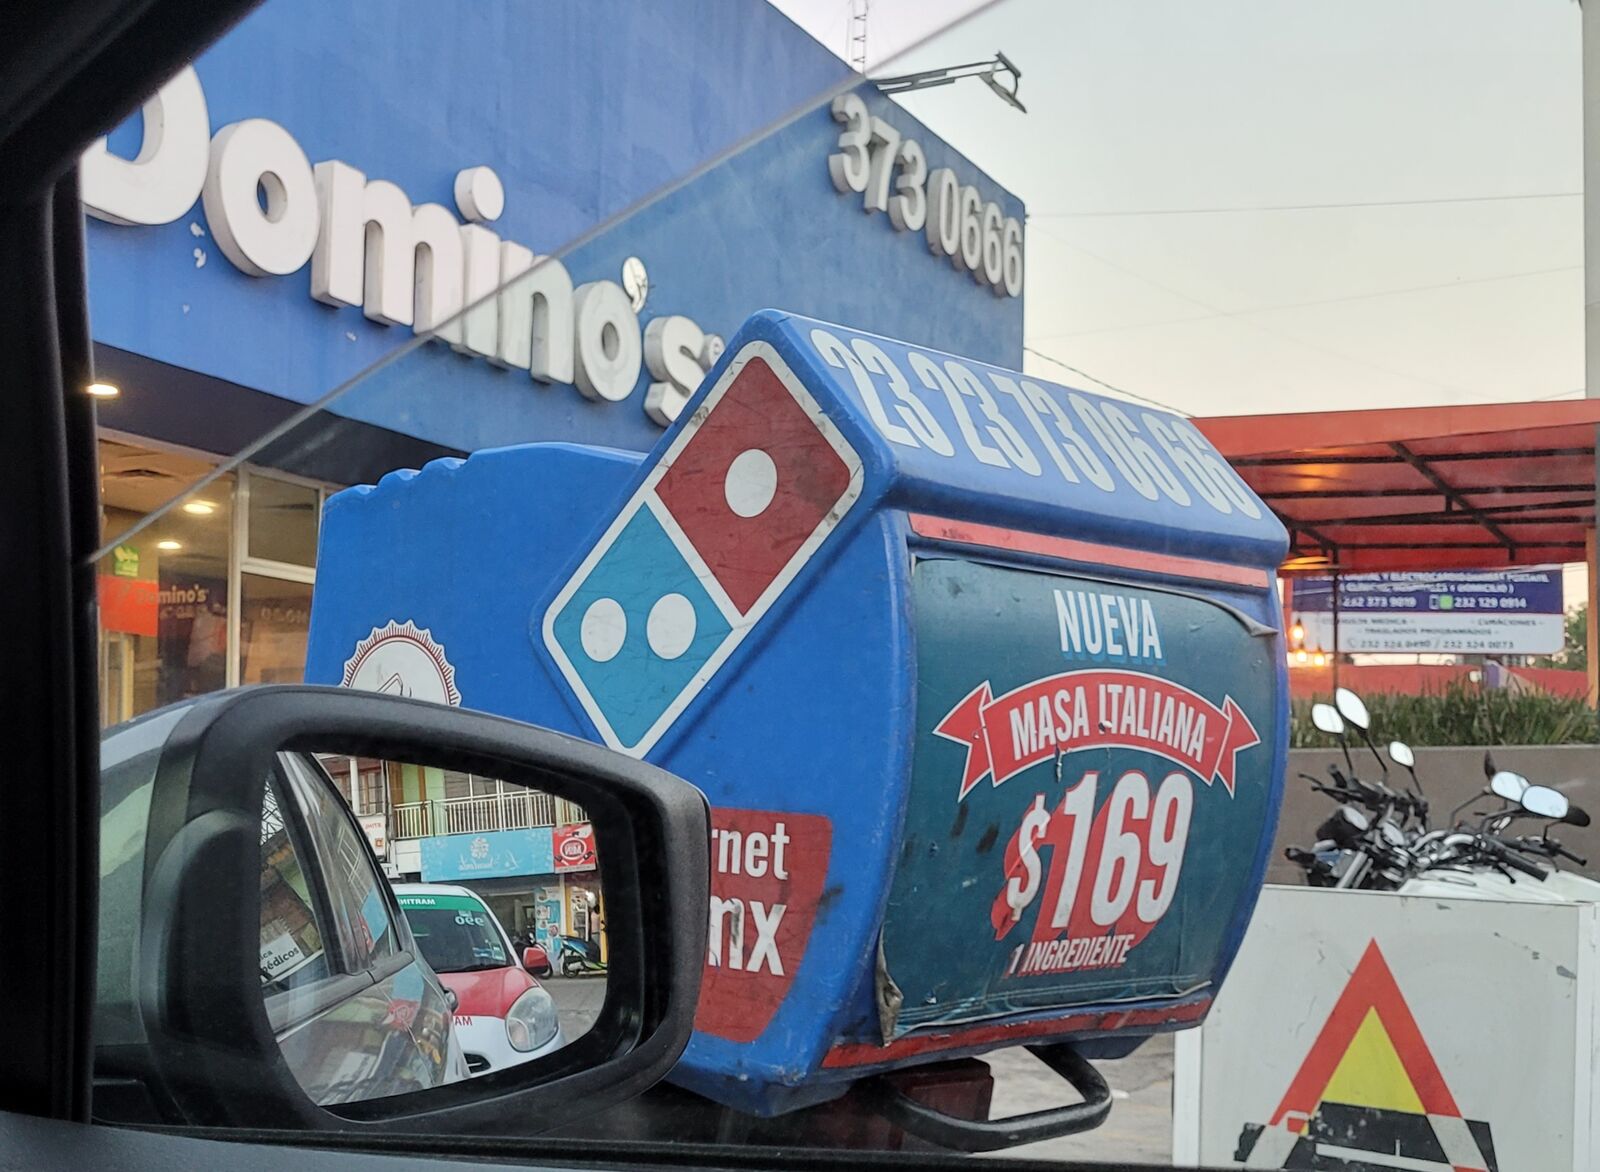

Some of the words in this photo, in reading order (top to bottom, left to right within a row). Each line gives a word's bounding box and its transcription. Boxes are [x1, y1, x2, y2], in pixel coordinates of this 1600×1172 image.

[1053, 589, 1164, 662] NUEVA
[1008, 685, 1090, 761] MASA
[1097, 683, 1208, 763] ITALIANA
[1002, 771, 1194, 931] $169
[1009, 943, 1021, 975] 1
[1021, 933, 1136, 974] INGREDIENTE
